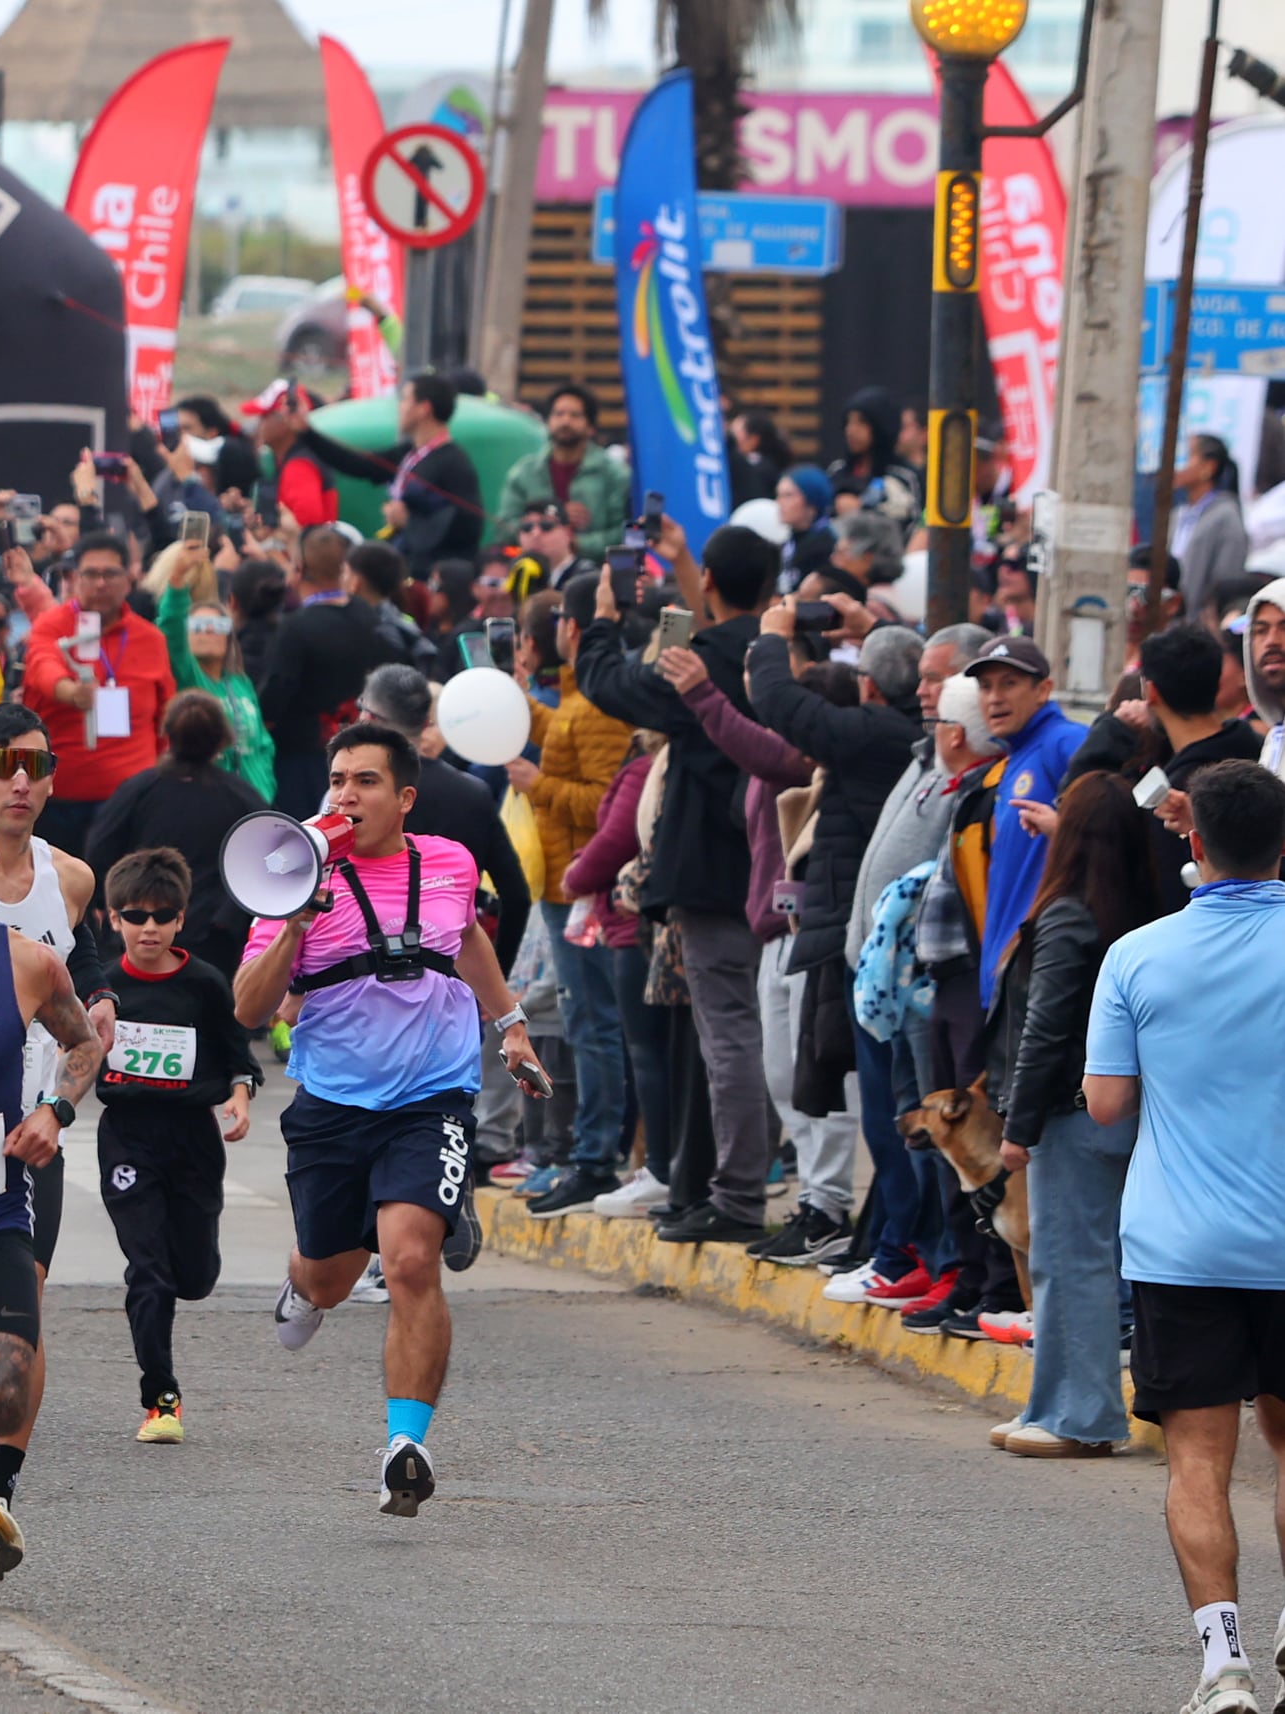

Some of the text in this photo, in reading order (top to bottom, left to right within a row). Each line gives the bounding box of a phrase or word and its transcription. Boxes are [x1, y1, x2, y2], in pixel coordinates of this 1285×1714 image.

[128, 185, 180, 309] Chile
[655, 202, 724, 519] Electrolit
[123, 1048, 183, 1077] 276
